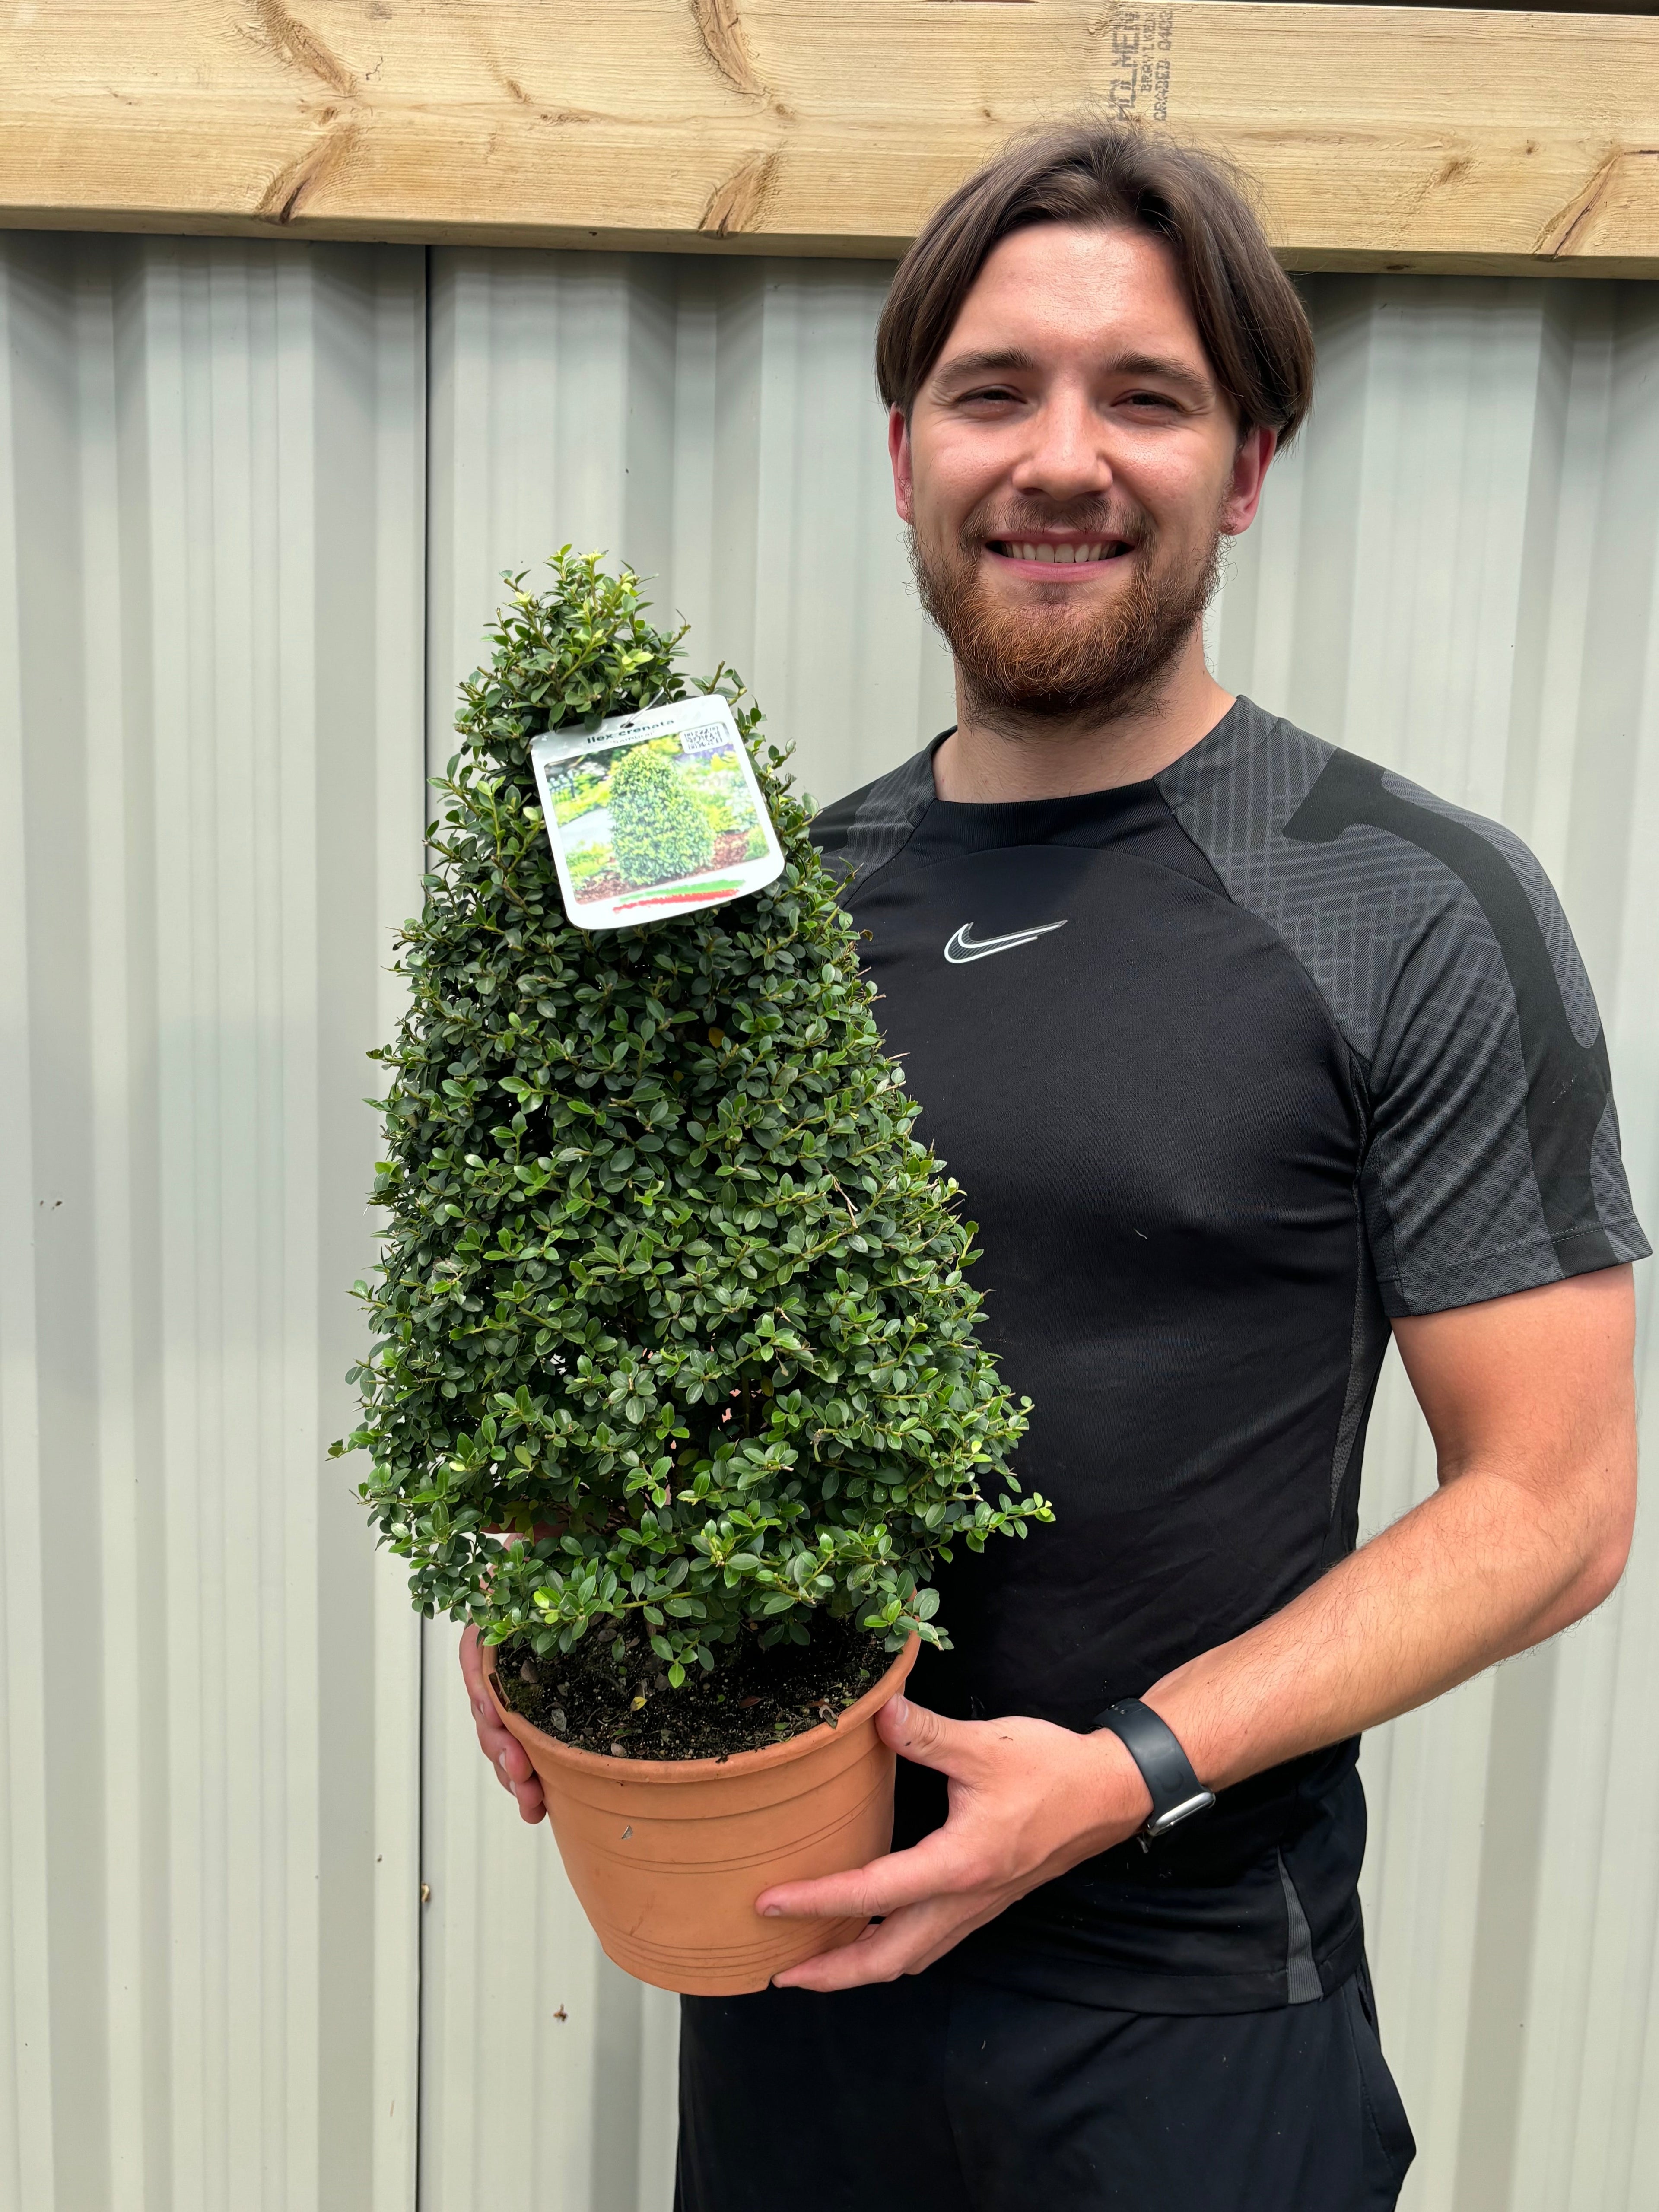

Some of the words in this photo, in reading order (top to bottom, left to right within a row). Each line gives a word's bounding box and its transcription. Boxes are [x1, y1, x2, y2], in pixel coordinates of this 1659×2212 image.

[1153, 59, 1170, 121] GRADED
[587, 734, 613, 744] Ilex
[618, 719, 674, 736] crenata
